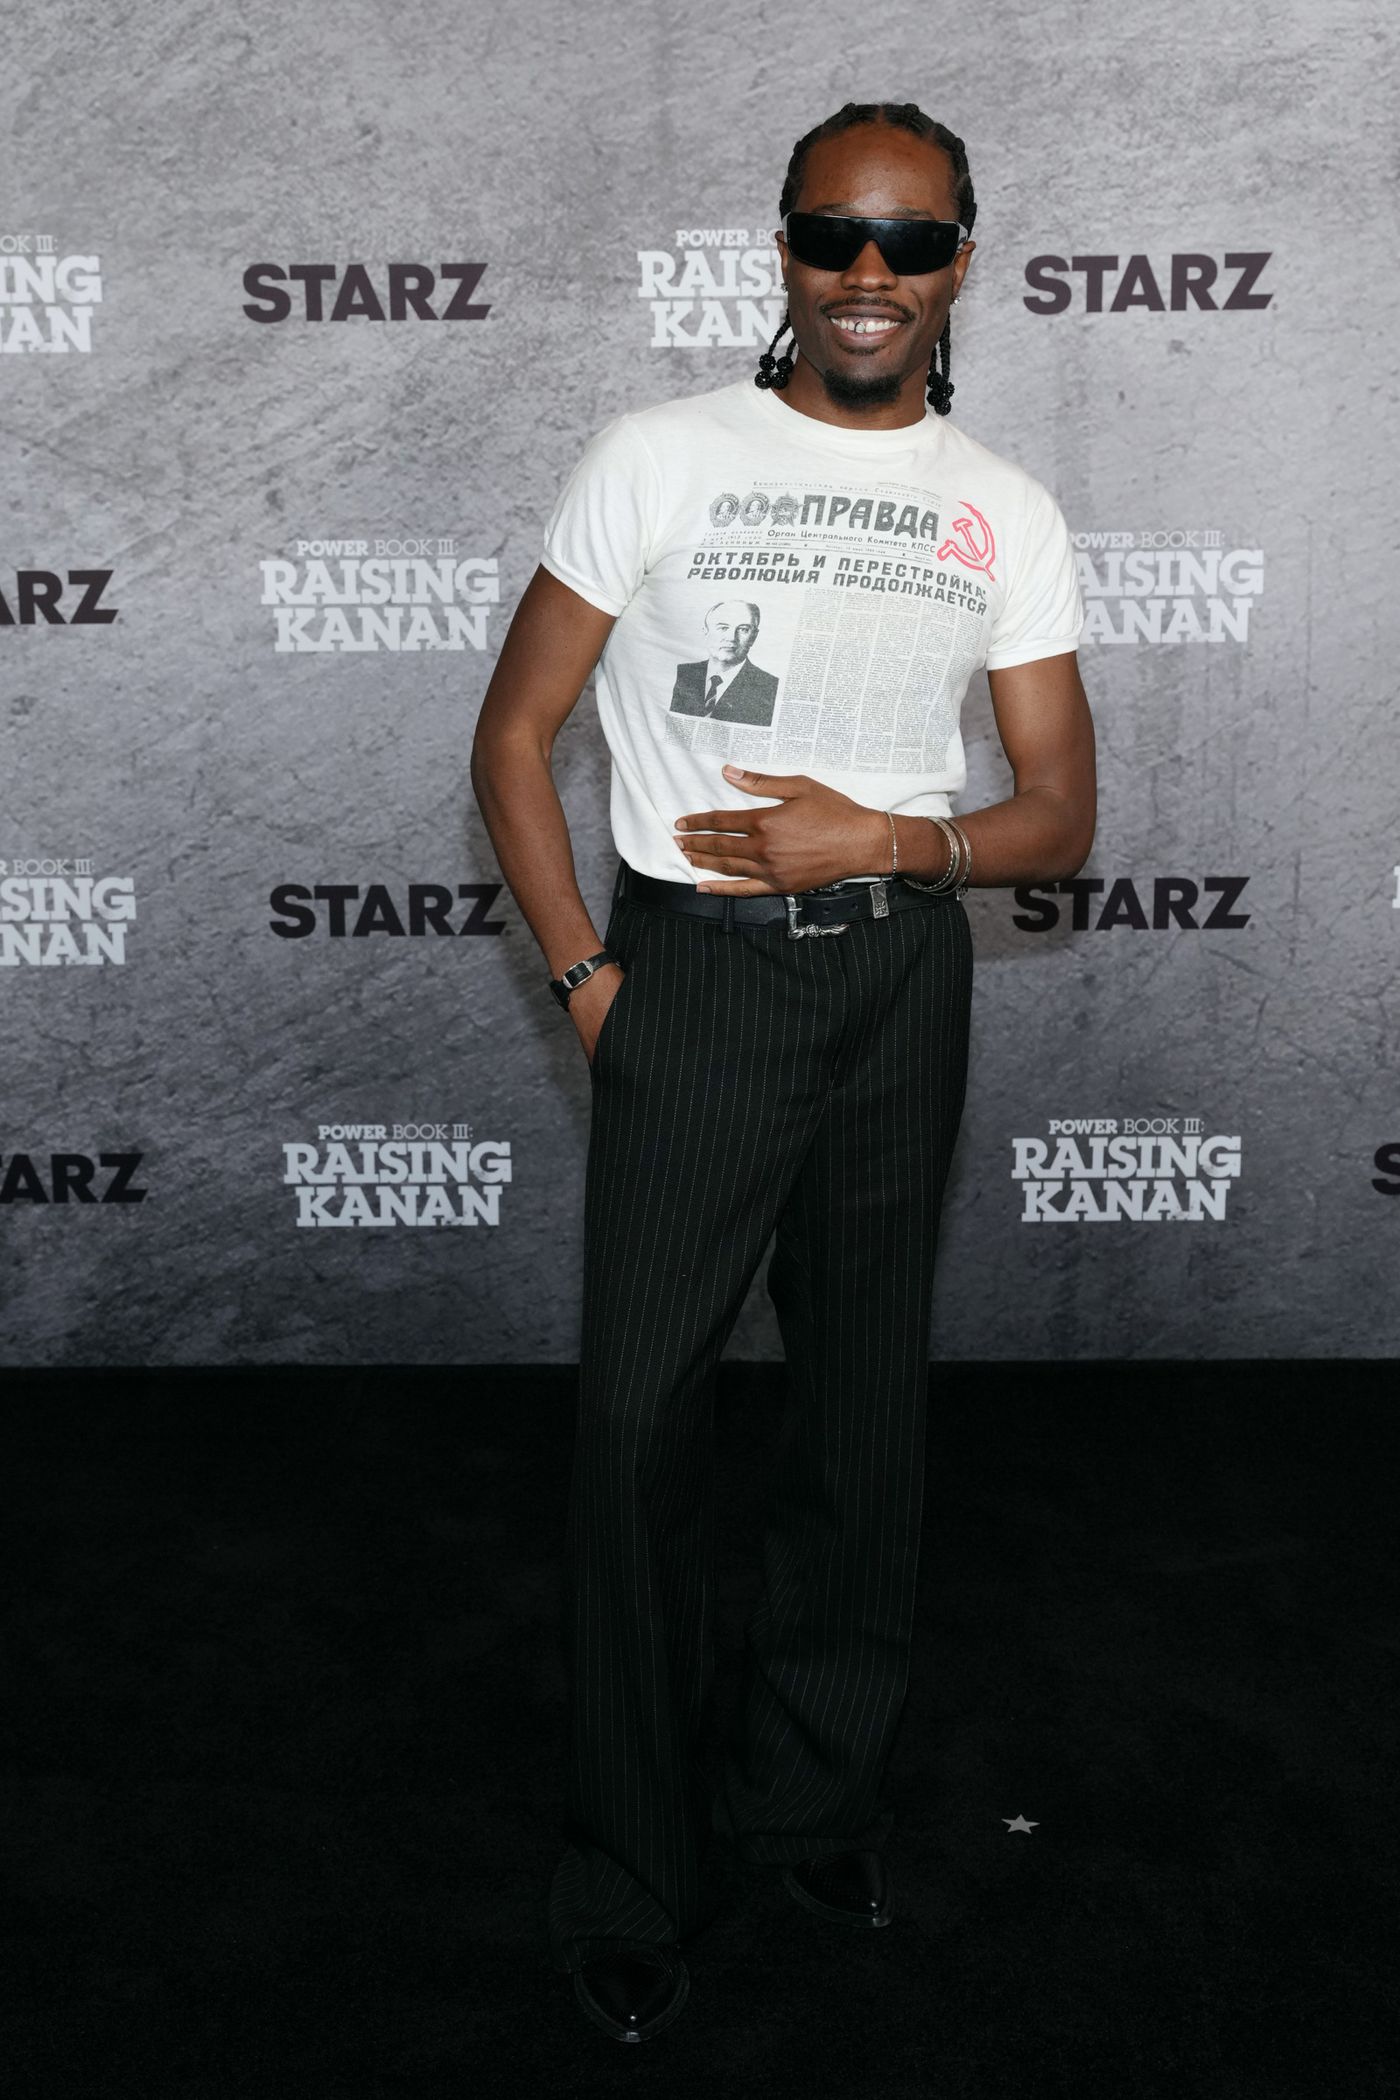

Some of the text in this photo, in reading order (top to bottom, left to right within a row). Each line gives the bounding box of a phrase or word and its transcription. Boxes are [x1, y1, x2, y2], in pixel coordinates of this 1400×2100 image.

[676, 229, 749, 247] POWER
[242, 262, 493, 323] STARZ
[1023, 252, 1274, 315] STARZ
[0, 306, 93, 352] AN
[650, 300, 790, 347] KAN
[799, 494, 940, 541] ПРАВДА
[1141, 531, 1199, 548] BOOK
[297, 540, 368, 557] POWER
[374, 539, 433, 556] BOOK
[693, 552, 800, 567] ОКТЯБРЬ
[812, 554, 827, 569] И
[911, 541, 936, 553] КПСС
[259, 558, 499, 605] RAISING
[687, 568, 820, 584] РЕВОЛЮЦИЯ
[833, 573, 987, 616] ПРОДОЛЖАЕТСЯ
[1075, 549, 1264, 597] AISING
[273, 606, 490, 652] KANAN
[1079, 598, 1253, 644] ANAN
[13, 859, 70, 875] BOOK
[269, 884, 507, 938] STARZ
[1012, 877, 1251, 933] STARZ
[318, 1125, 386, 1140] POWER
[393, 1124, 449, 1139] BOOK
[1049, 1119, 1118, 1135] POWER
[1123, 1118, 1180, 1134] BOOK
[0, 1153, 148, 1203] ARZ
[282, 1141, 512, 1184] RAISING
[1011, 1135, 1242, 1179] RAISING
[295, 1185, 503, 1227] KANAN
[1021, 1180, 1231, 1222] KANAN
